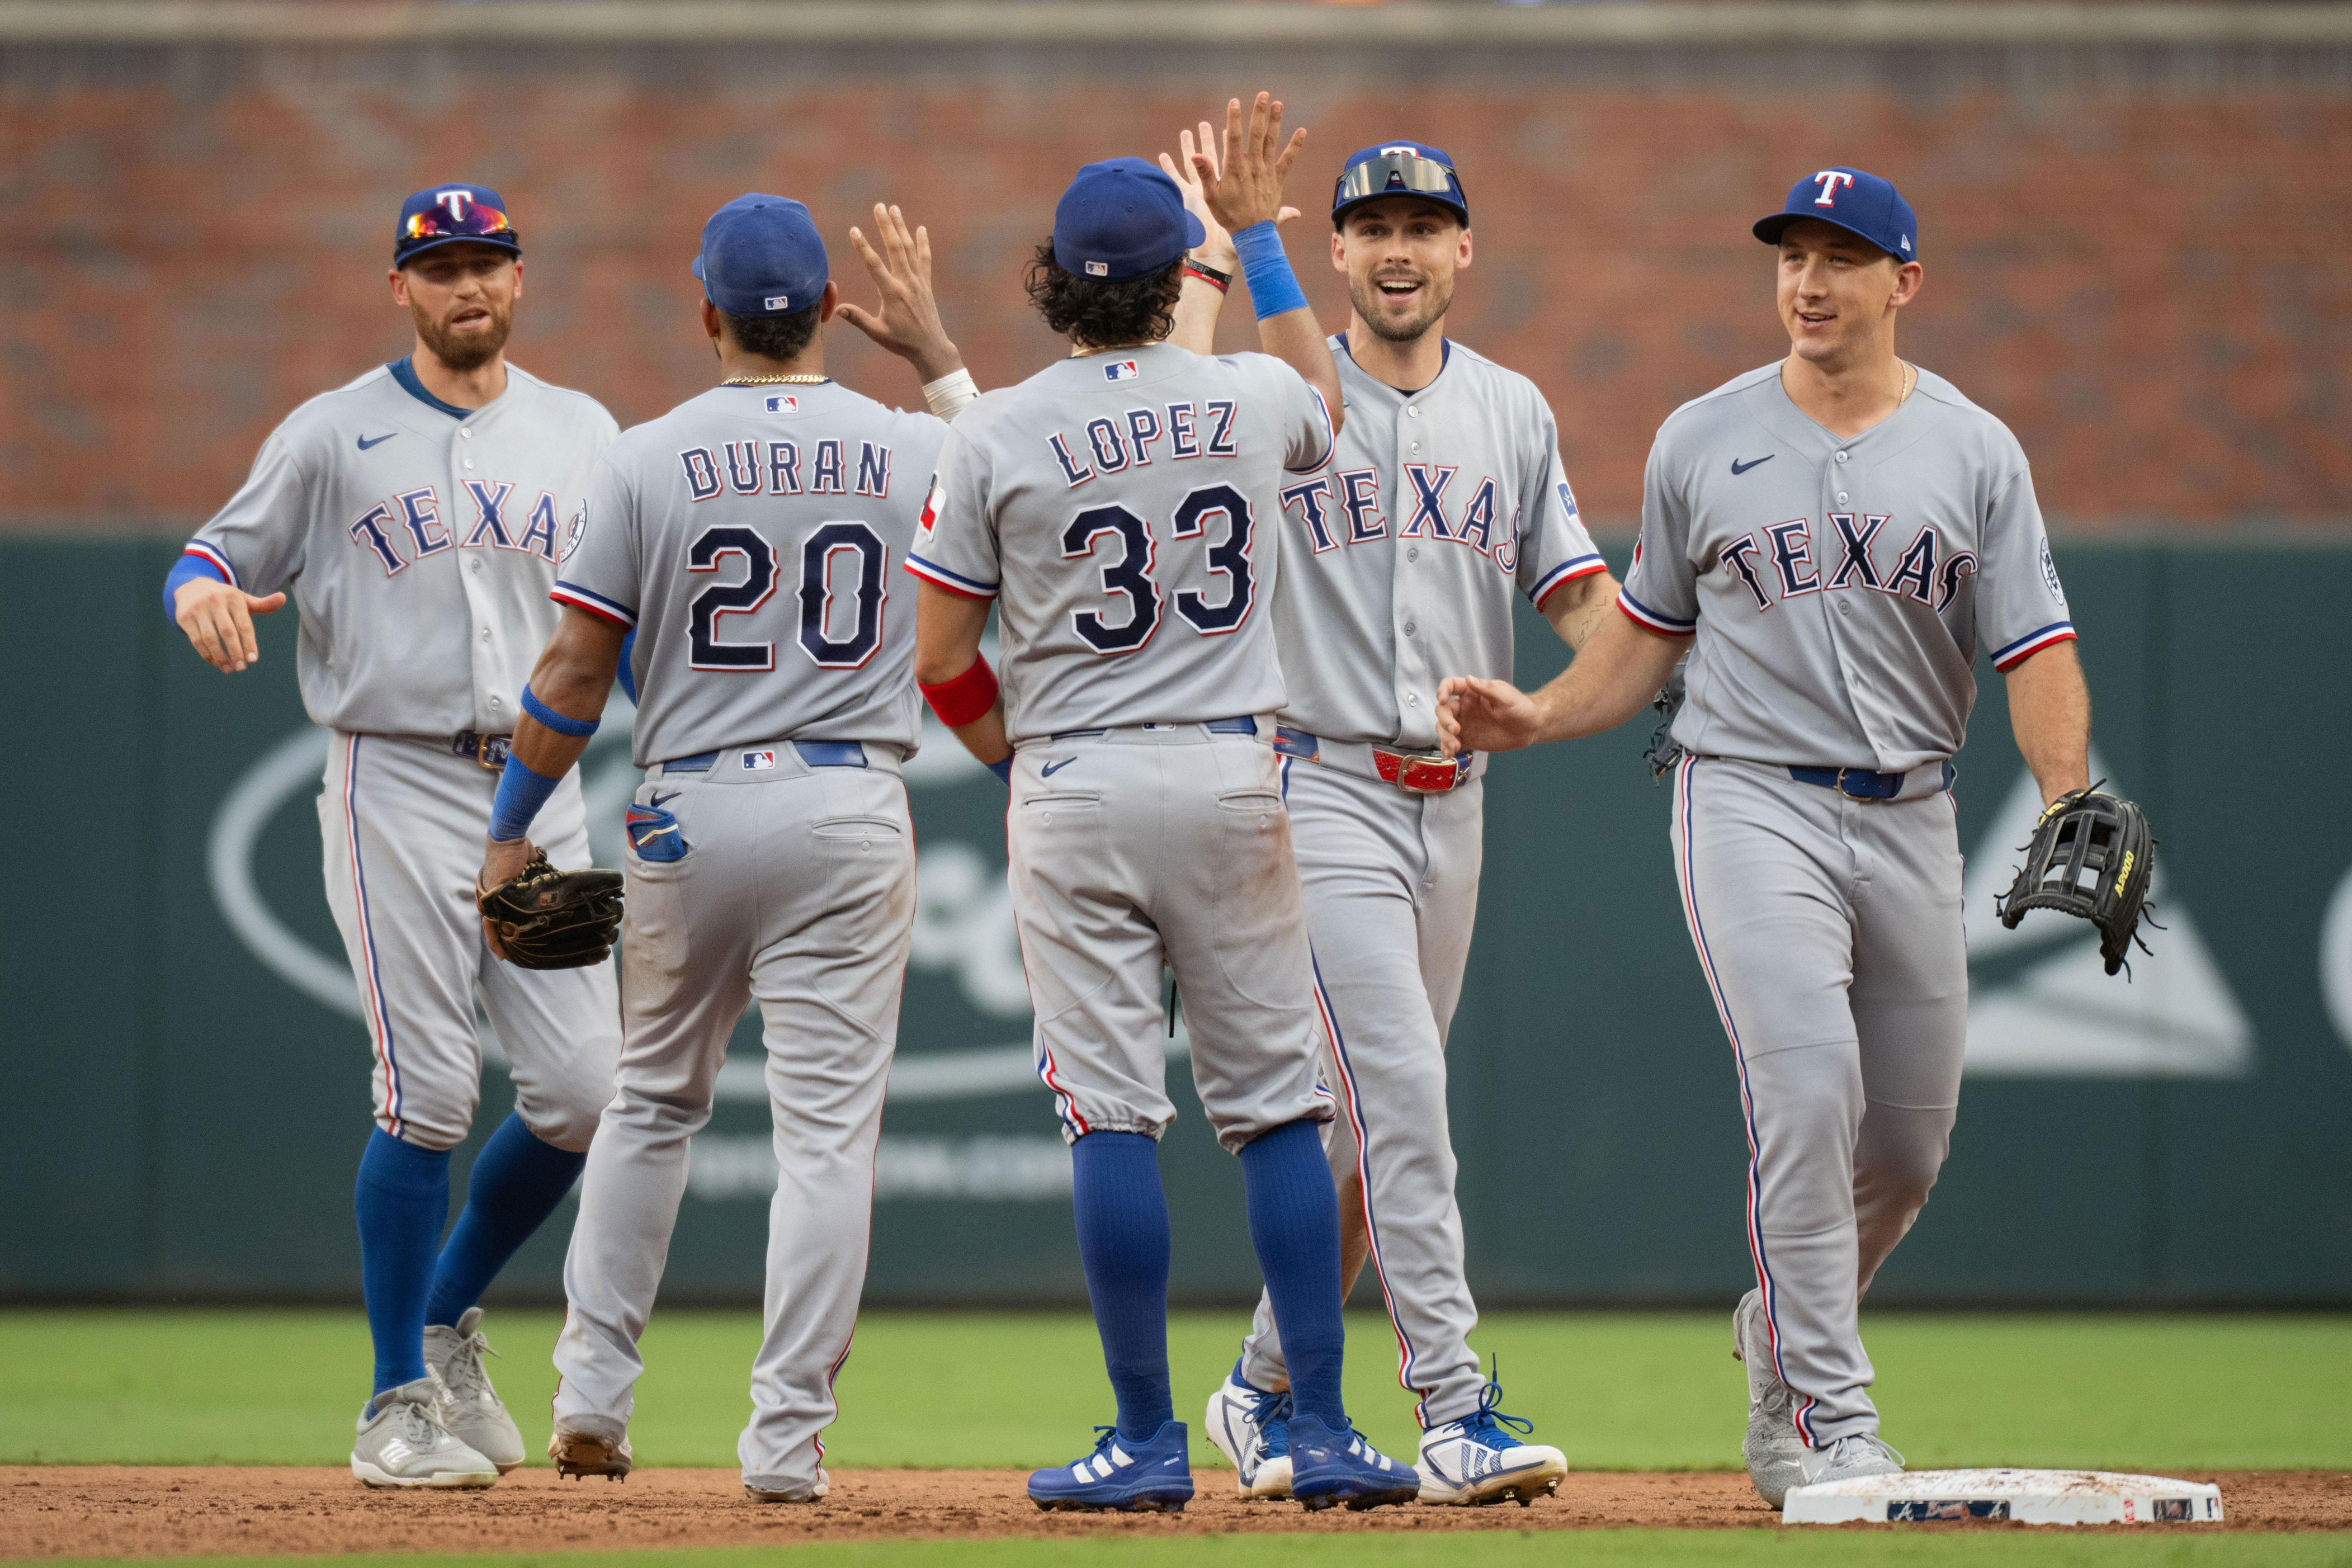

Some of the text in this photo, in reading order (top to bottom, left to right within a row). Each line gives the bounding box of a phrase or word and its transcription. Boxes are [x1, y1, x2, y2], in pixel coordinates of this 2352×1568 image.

[436, 190, 475, 221] T
[1815, 171, 1854, 208] T
[1187, 259, 1210, 273] JESU
[677, 439, 891, 503] DURAN
[1045, 399, 1238, 488] LOPEZ
[348, 479, 578, 578] TEXA
[685, 521, 889, 671] 20
[1060, 480, 1256, 655] 33
[2115, 850, 2134, 898] A2000
